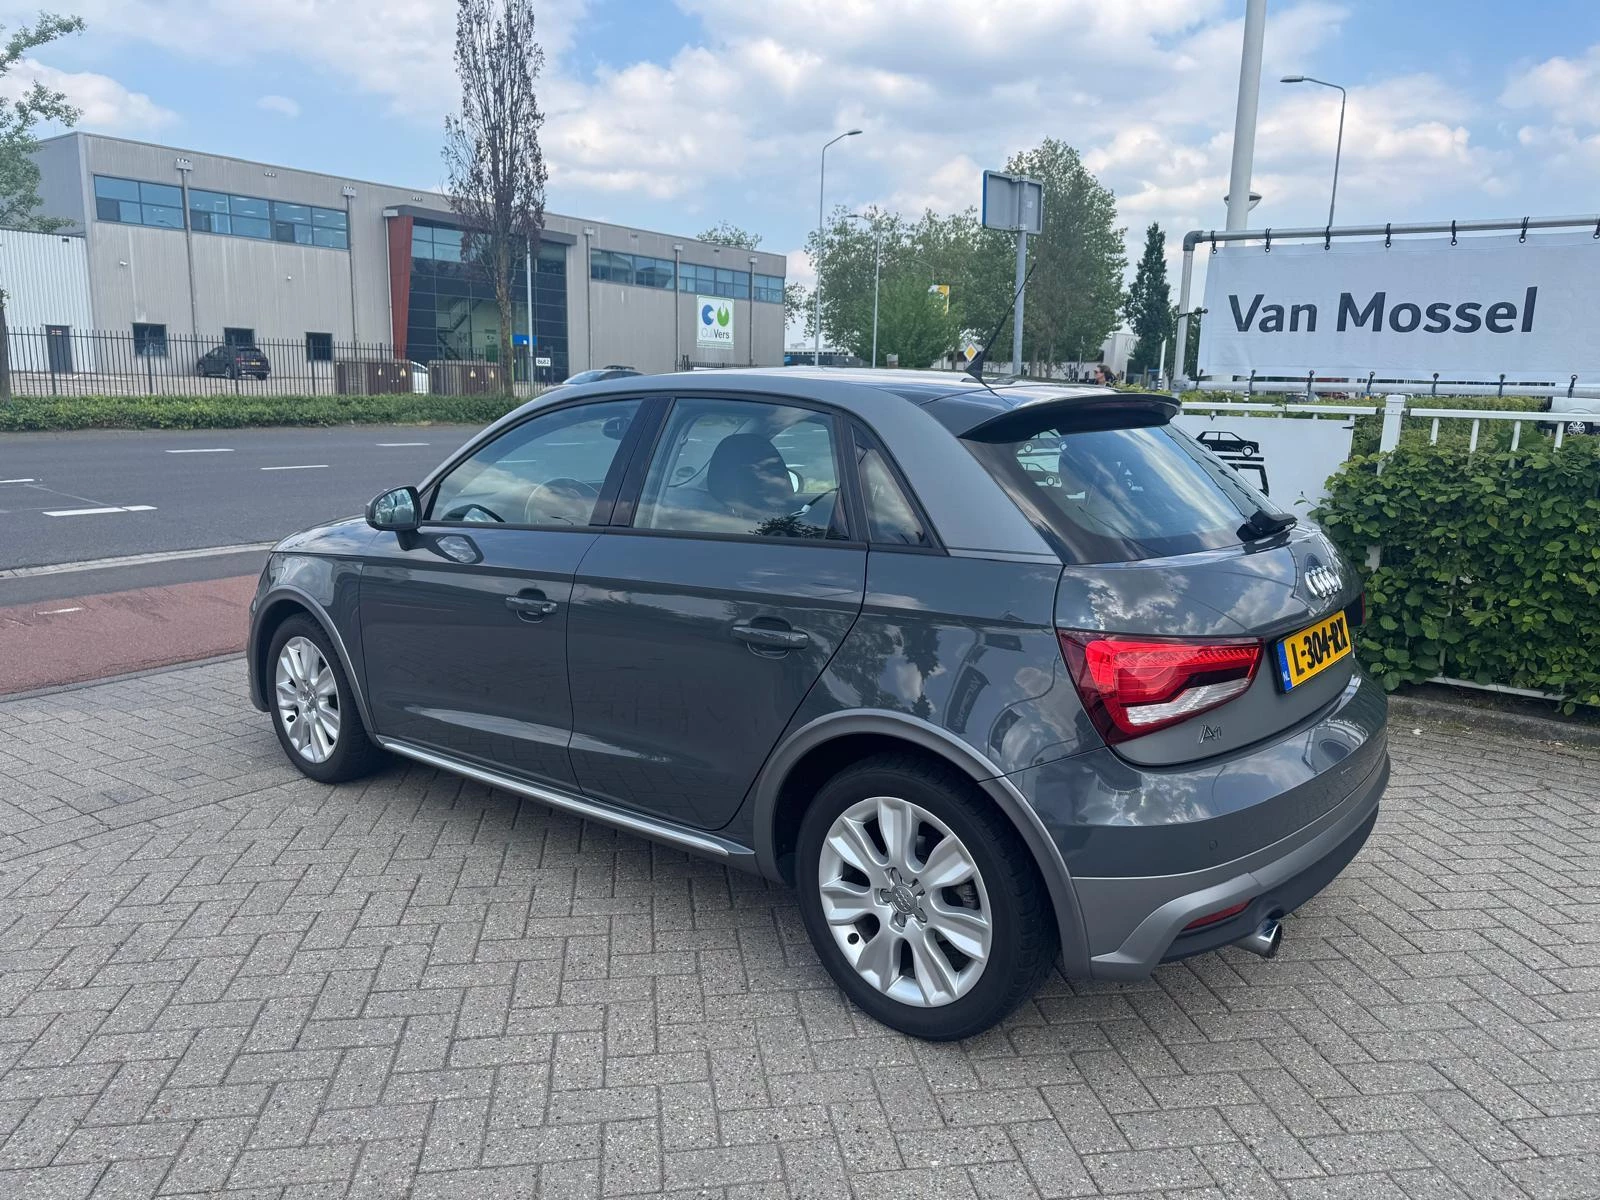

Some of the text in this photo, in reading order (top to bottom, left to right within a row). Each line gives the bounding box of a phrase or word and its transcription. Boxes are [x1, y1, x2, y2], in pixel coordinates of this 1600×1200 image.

[1228, 286, 1538, 334] Van Mossel
[701, 327, 730, 339] CVers
[1291, 617, 1348, 676] L-304-RX
[1283, 671, 1290, 682] NL
[1199, 724, 1222, 744] A1
